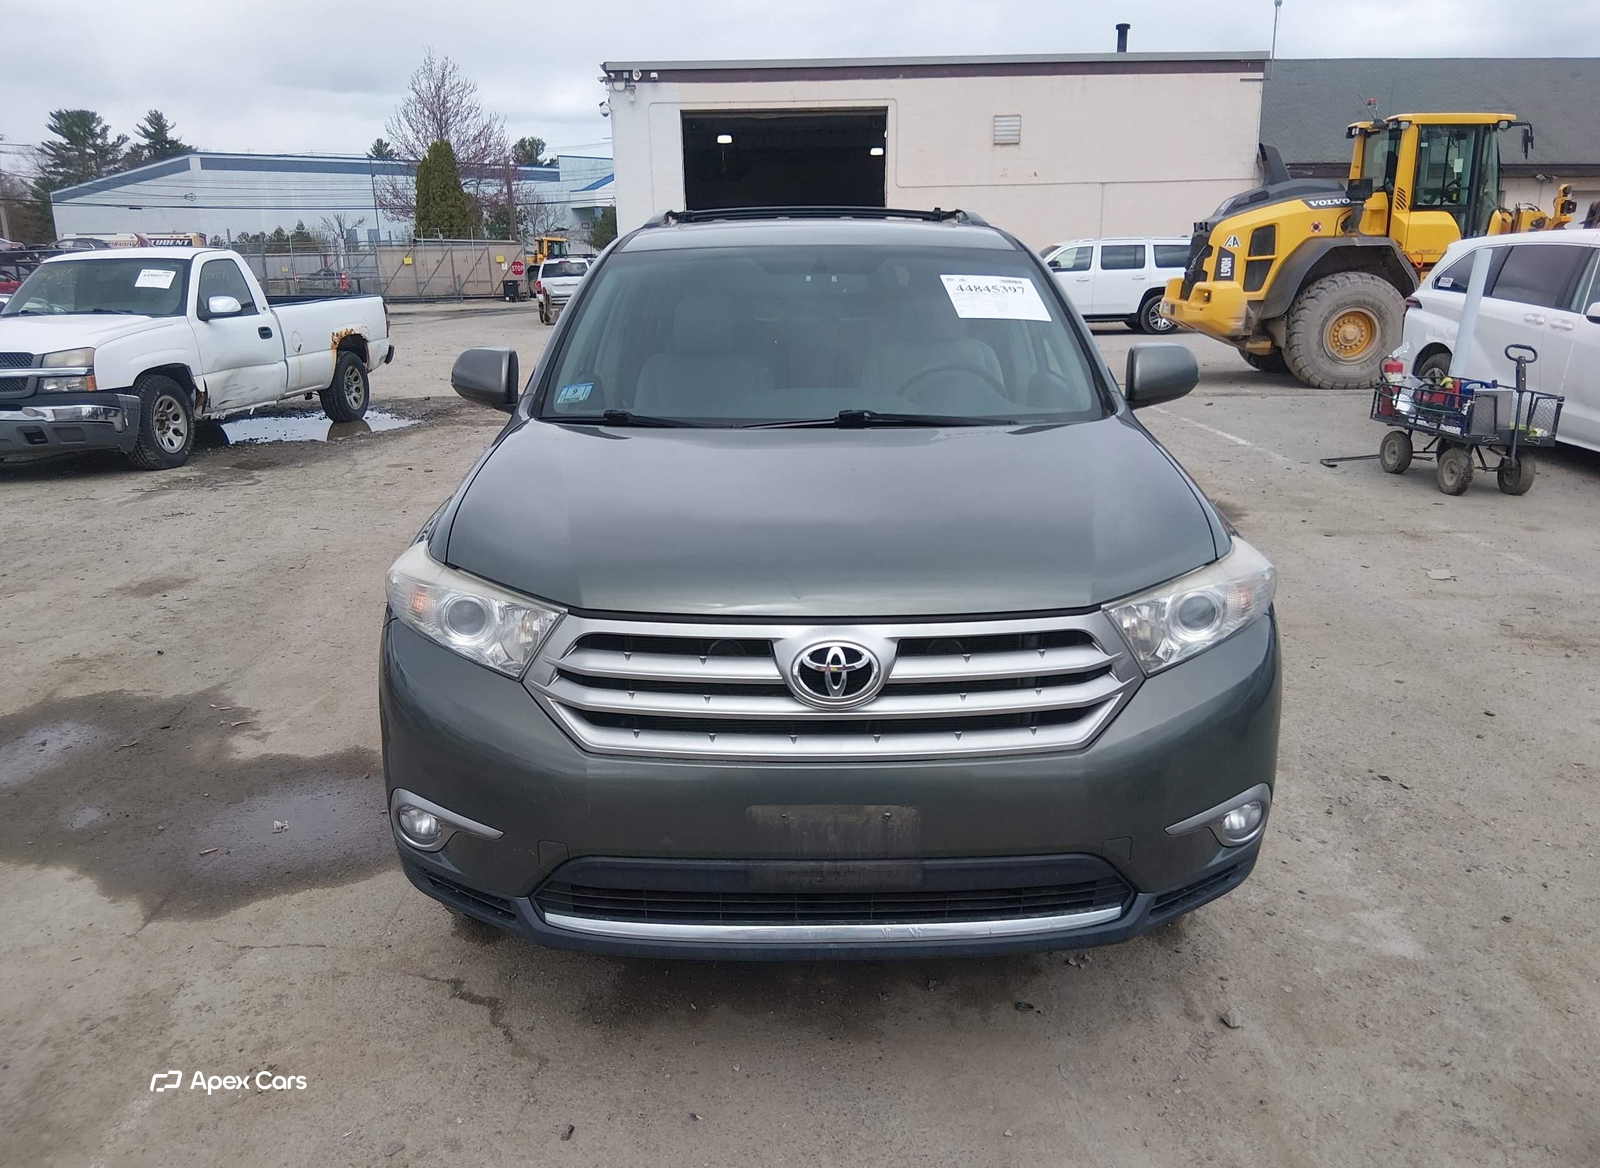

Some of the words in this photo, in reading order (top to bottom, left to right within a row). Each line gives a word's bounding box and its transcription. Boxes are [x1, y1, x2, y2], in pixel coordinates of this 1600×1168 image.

[1309, 198, 1350, 207] VOLVO
[1220, 257, 1232, 277] L90H
[956, 284, 1025, 294] 44845397
